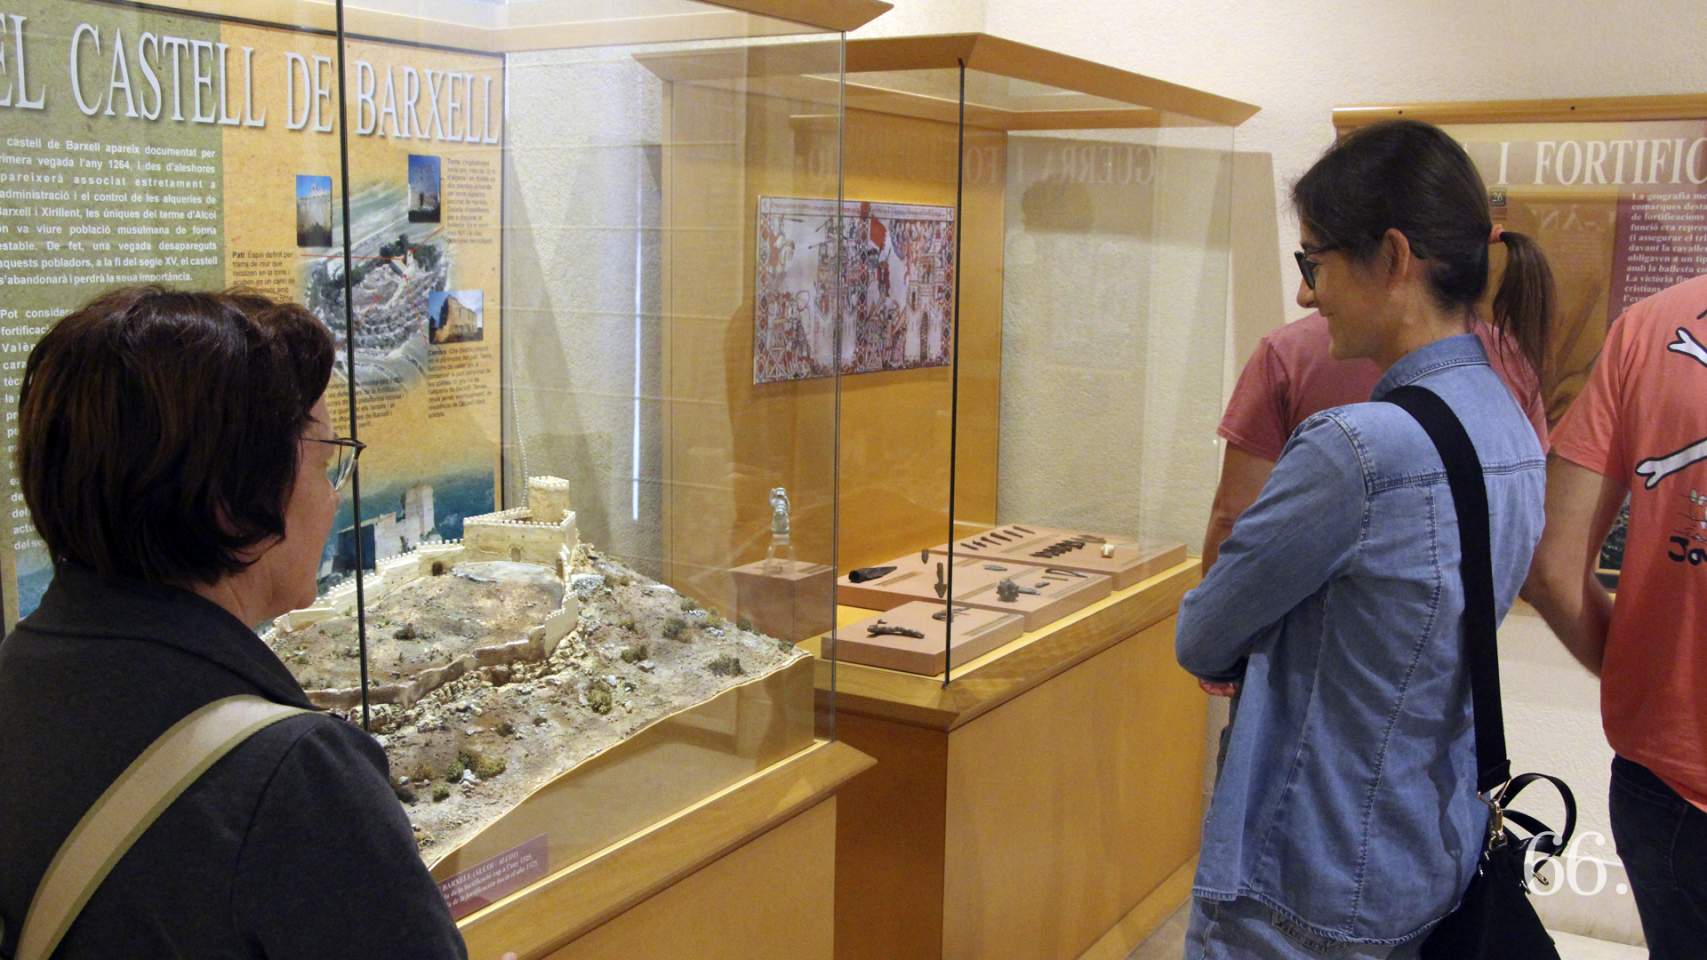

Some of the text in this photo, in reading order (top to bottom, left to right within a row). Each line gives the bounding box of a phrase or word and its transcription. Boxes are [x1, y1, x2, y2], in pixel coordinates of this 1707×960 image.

[70, 23, 266, 127] CASTELL
[284, 50, 335, 133] DE
[354, 58, 500, 145] BARXELL
[7, 138, 42, 149] castell
[48, 139, 60, 149] de
[65, 140, 101, 152] Barxell
[105, 143, 140, 155] apareix
[201, 149, 217, 160] per
[38, 157, 75, 169] vegada
[80, 158, 103, 170] l'any
[145, 161, 161, 171] des
[166, 162, 216, 173] d'aleshores
[1497, 142, 1512, 185] I
[73, 175, 126, 186] associat
[136, 178, 202, 188] estretament
[210, 181, 216, 190] a
[81, 191, 90, 201] el
[95, 192, 128, 202] control
[131, 193, 142, 202] de
[145, 193, 160, 203] les
[163, 194, 202, 205] alqueries
[206, 194, 217, 204] de
[1632, 191, 1645, 200] La
[86, 208, 100, 217] les
[143, 209, 157, 219] del
[160, 210, 185, 219] terme
[187, 210, 217, 220] d'Alcoi
[1631, 204, 1681, 213] comarques
[1631, 212, 1705, 221] de fortificacions
[16, 225, 29, 233] va
[36, 224, 62, 233] viure
[70, 225, 111, 236] població
[117, 225, 170, 235] musulmana
[176, 225, 187, 234] de
[192, 225, 217, 235] forma
[1631, 223, 1659, 231] funció
[1638, 234, 1682, 243] assegurar
[1684, 233, 1693, 241] el
[46, 240, 61, 251] De
[68, 240, 84, 252] fet,
[93, 242, 111, 251] una
[119, 241, 152, 253] vegada
[159, 241, 217, 252] desapareguts
[1628, 244, 1660, 252] davant
[1661, 244, 1671, 252] la
[41, 258, 94, 270] pobladors,
[96, 259, 102, 267] a
[104, 257, 112, 267] la
[115, 257, 121, 267] fi
[123, 257, 137, 267] del
[139, 257, 163, 269] segle
[181, 256, 189, 266] el
[190, 255, 218, 266] castell
[1627, 253, 1671, 263] obligaven
[1626, 264, 1647, 272] amb
[1648, 264, 1657, 273] la
[1659, 264, 1695, 273] ballesta
[74, 274, 105, 287] perdrà
[107, 273, 114, 283] la
[139, 271, 192, 282] importància.
[1625, 273, 1638, 282] La
[0, 308, 18, 319] Pot
